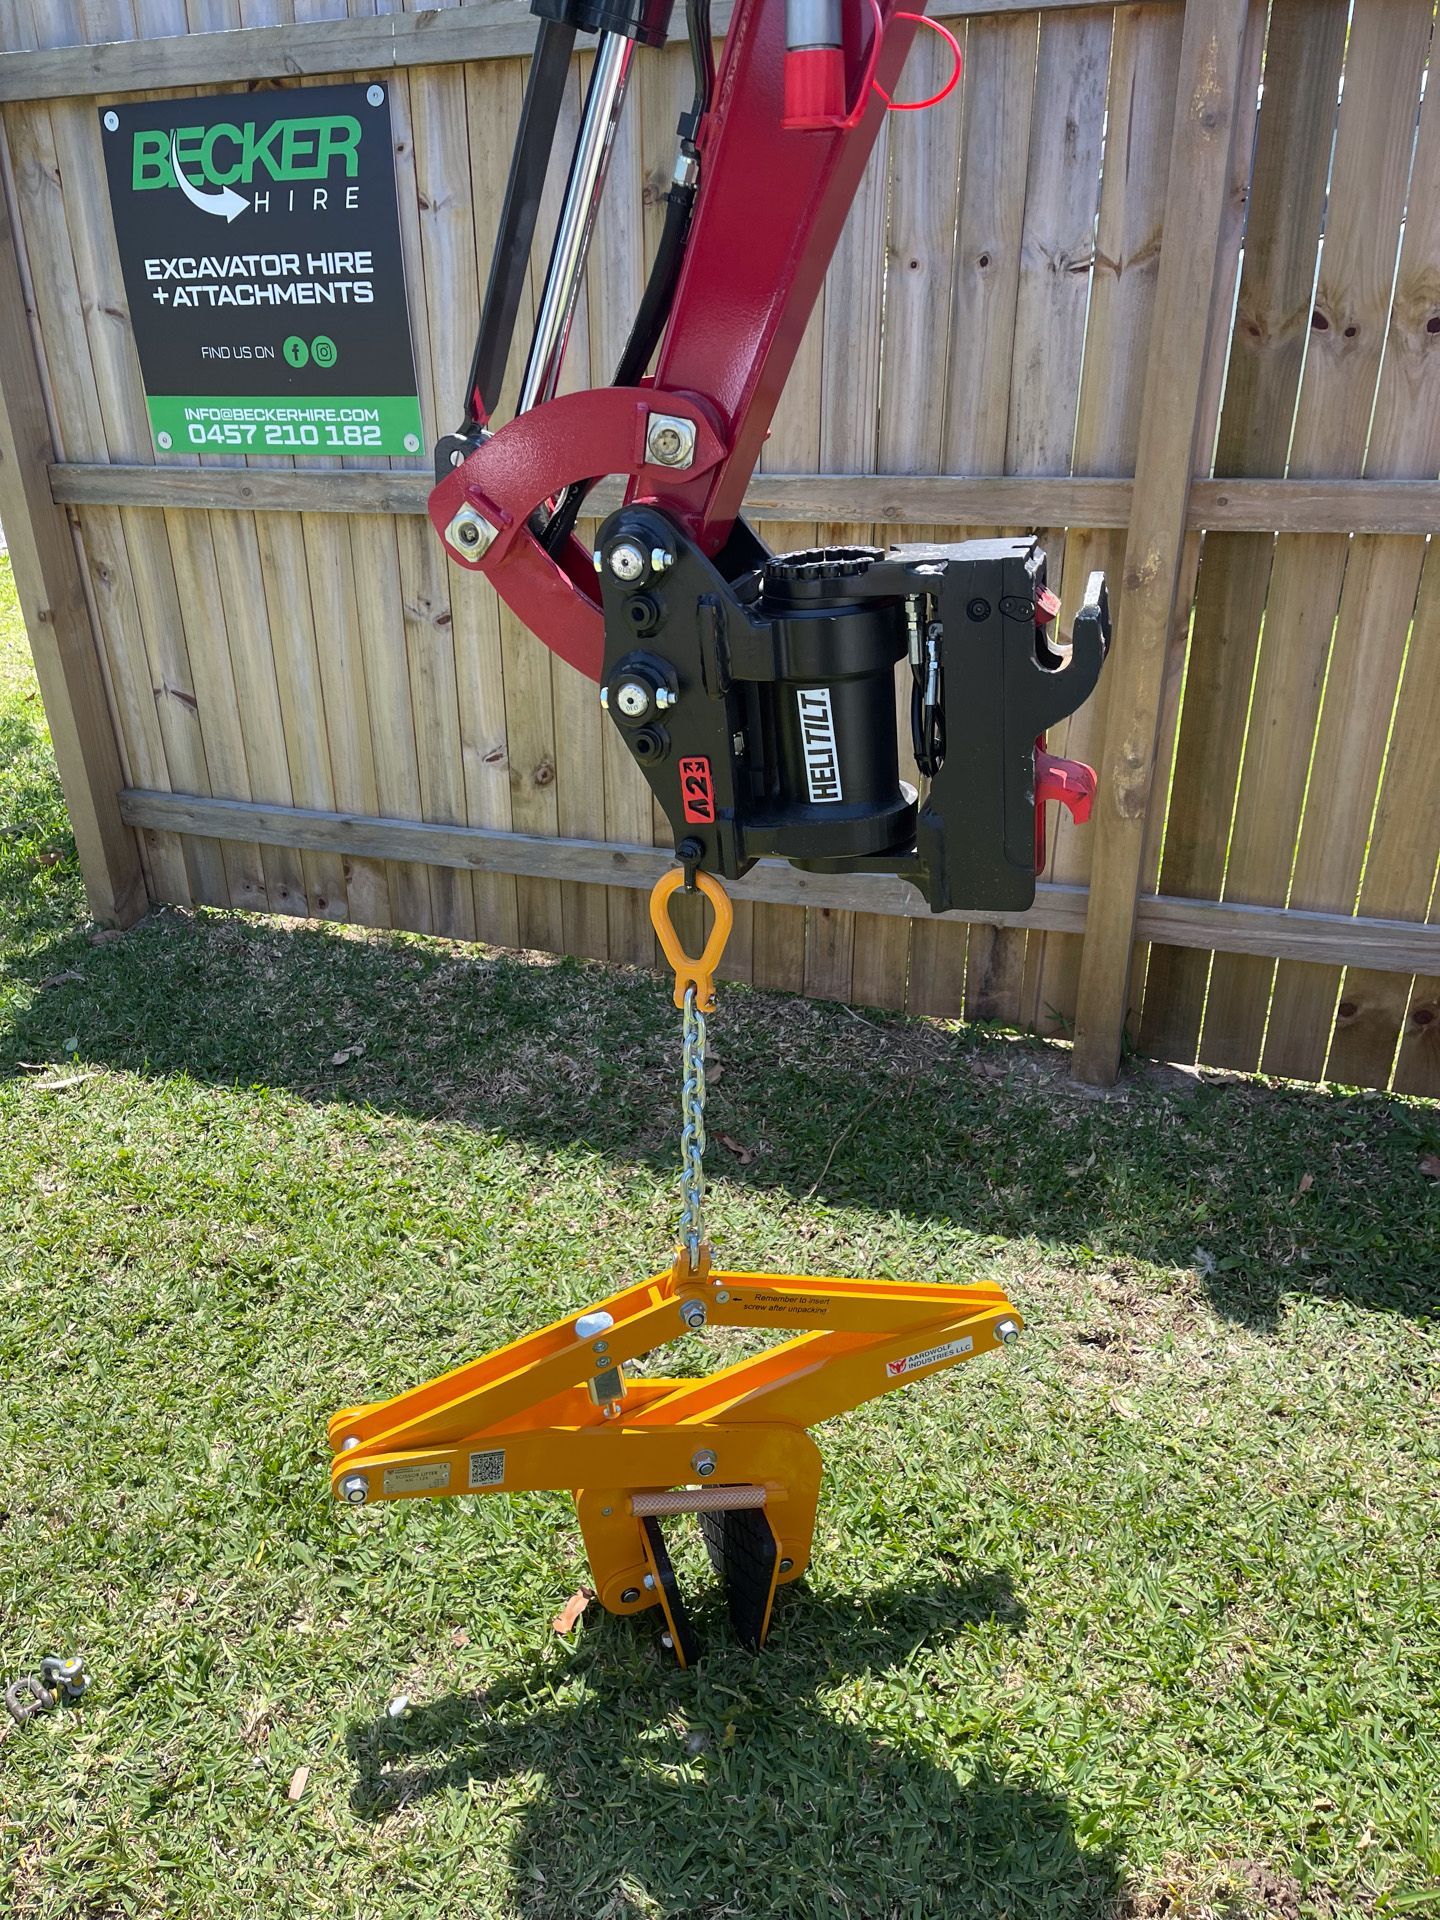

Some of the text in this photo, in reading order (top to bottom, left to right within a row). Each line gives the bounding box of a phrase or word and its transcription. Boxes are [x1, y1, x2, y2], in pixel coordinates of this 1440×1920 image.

[132, 115, 362, 190] BECKER
[254, 186, 359, 213] HIRE
[144, 251, 374, 280] EXCAVATOR HIRE
[201, 346, 275, 359] FIND US ON
[184, 407, 379, 422] INFO@BECKERHIRE.COM
[188, 424, 382, 446] 0457 210 182
[754, 1293, 798, 1304] Remember
[799, 1296, 807, 1304] to
[744, 1303, 829, 1315] screw after unpacking
[908, 1343, 953, 1362] AARDWOLF
[908, 1344, 971, 1369] INDUSTRIES LLC
